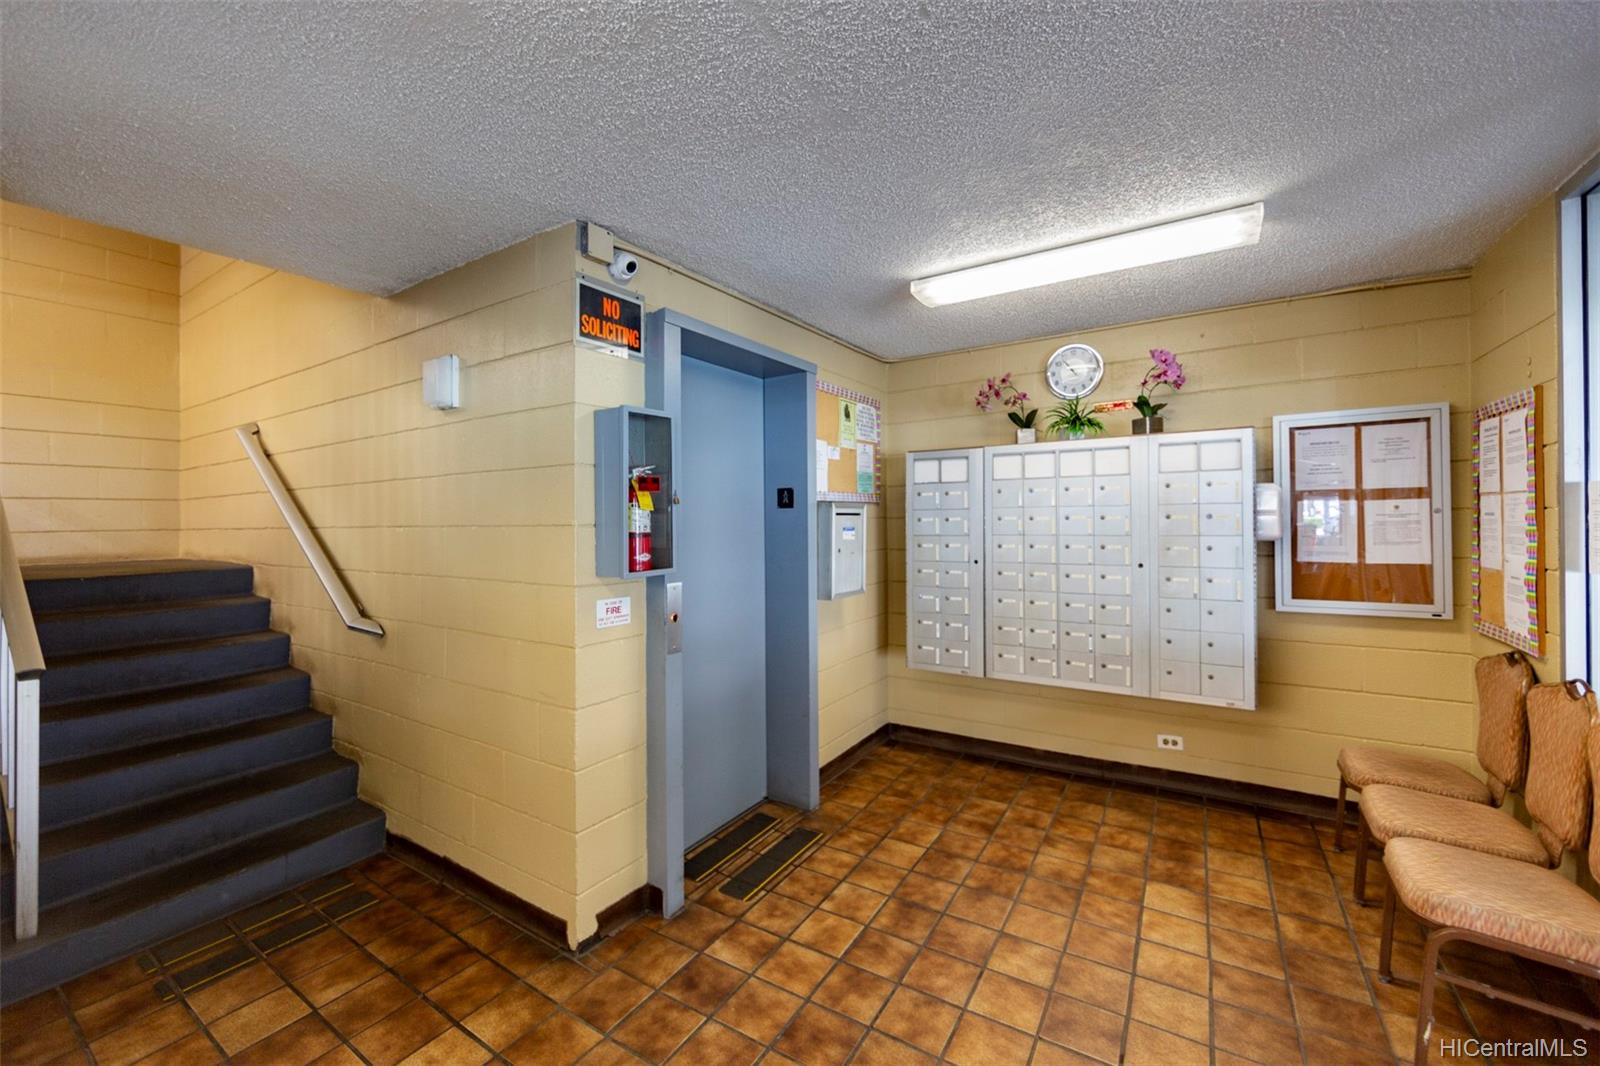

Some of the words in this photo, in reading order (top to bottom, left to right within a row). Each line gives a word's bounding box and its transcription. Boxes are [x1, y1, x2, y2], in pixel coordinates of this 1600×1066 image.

[603, 297, 620, 320] NO
[581, 314, 640, 348] SOLICITING
[605, 605, 622, 615] FIRE
